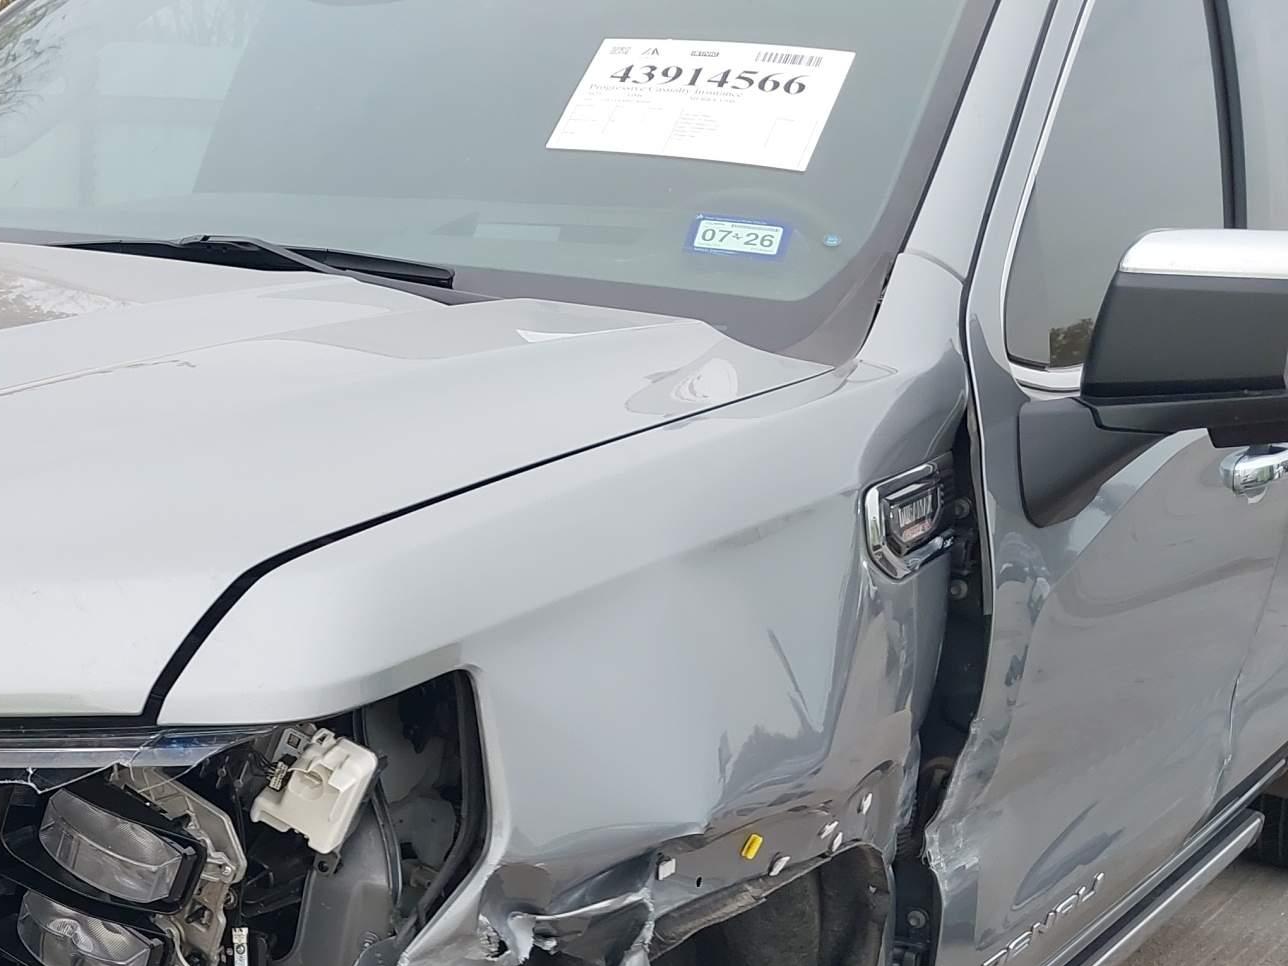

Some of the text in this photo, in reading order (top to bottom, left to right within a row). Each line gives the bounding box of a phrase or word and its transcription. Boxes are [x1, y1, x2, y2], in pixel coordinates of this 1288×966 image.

[609, 64, 809, 96] 43914566
[701, 228, 733, 243] 07
[743, 232, 776, 248] 26
